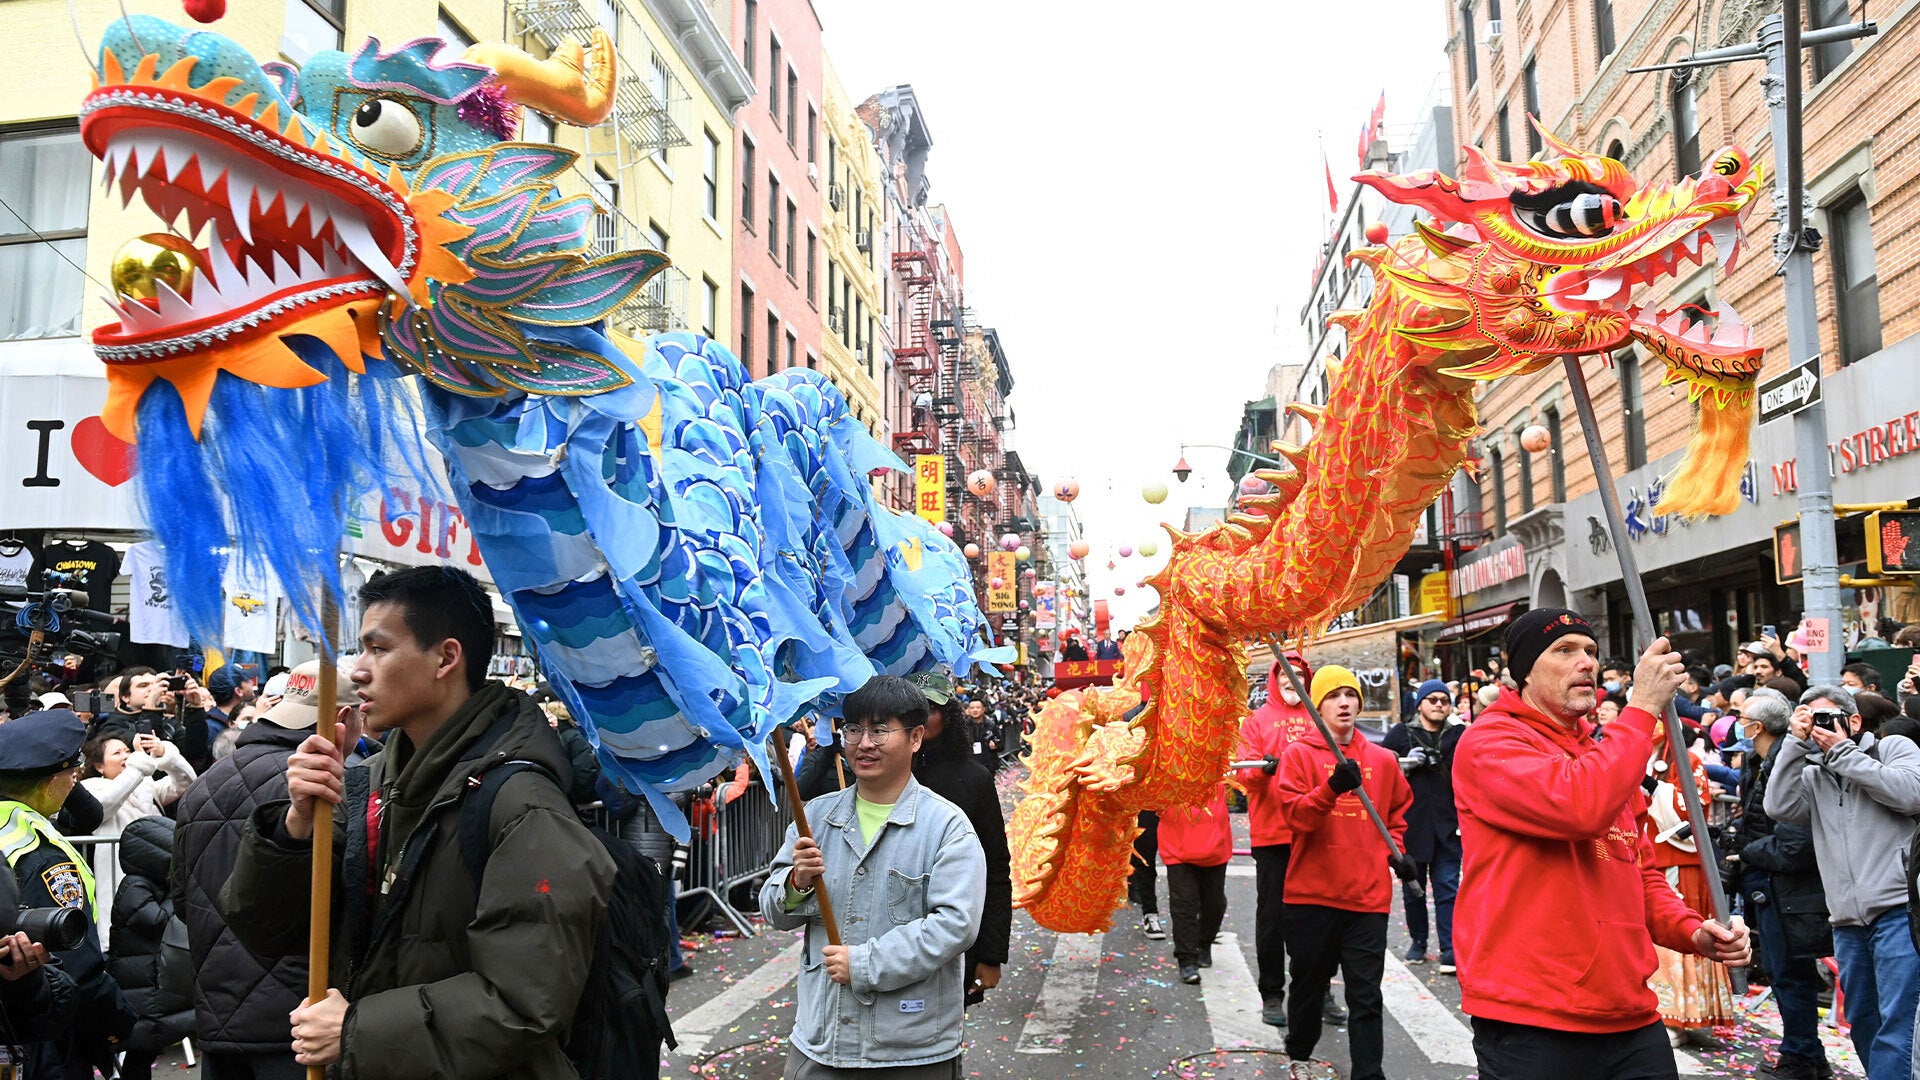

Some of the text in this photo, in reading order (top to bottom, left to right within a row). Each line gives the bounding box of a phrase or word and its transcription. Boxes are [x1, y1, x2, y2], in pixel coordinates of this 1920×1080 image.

[1766, 374, 1811, 410] ONE WAY
[22, 420, 64, 487] I
[921, 461, 940, 526] 明旺
